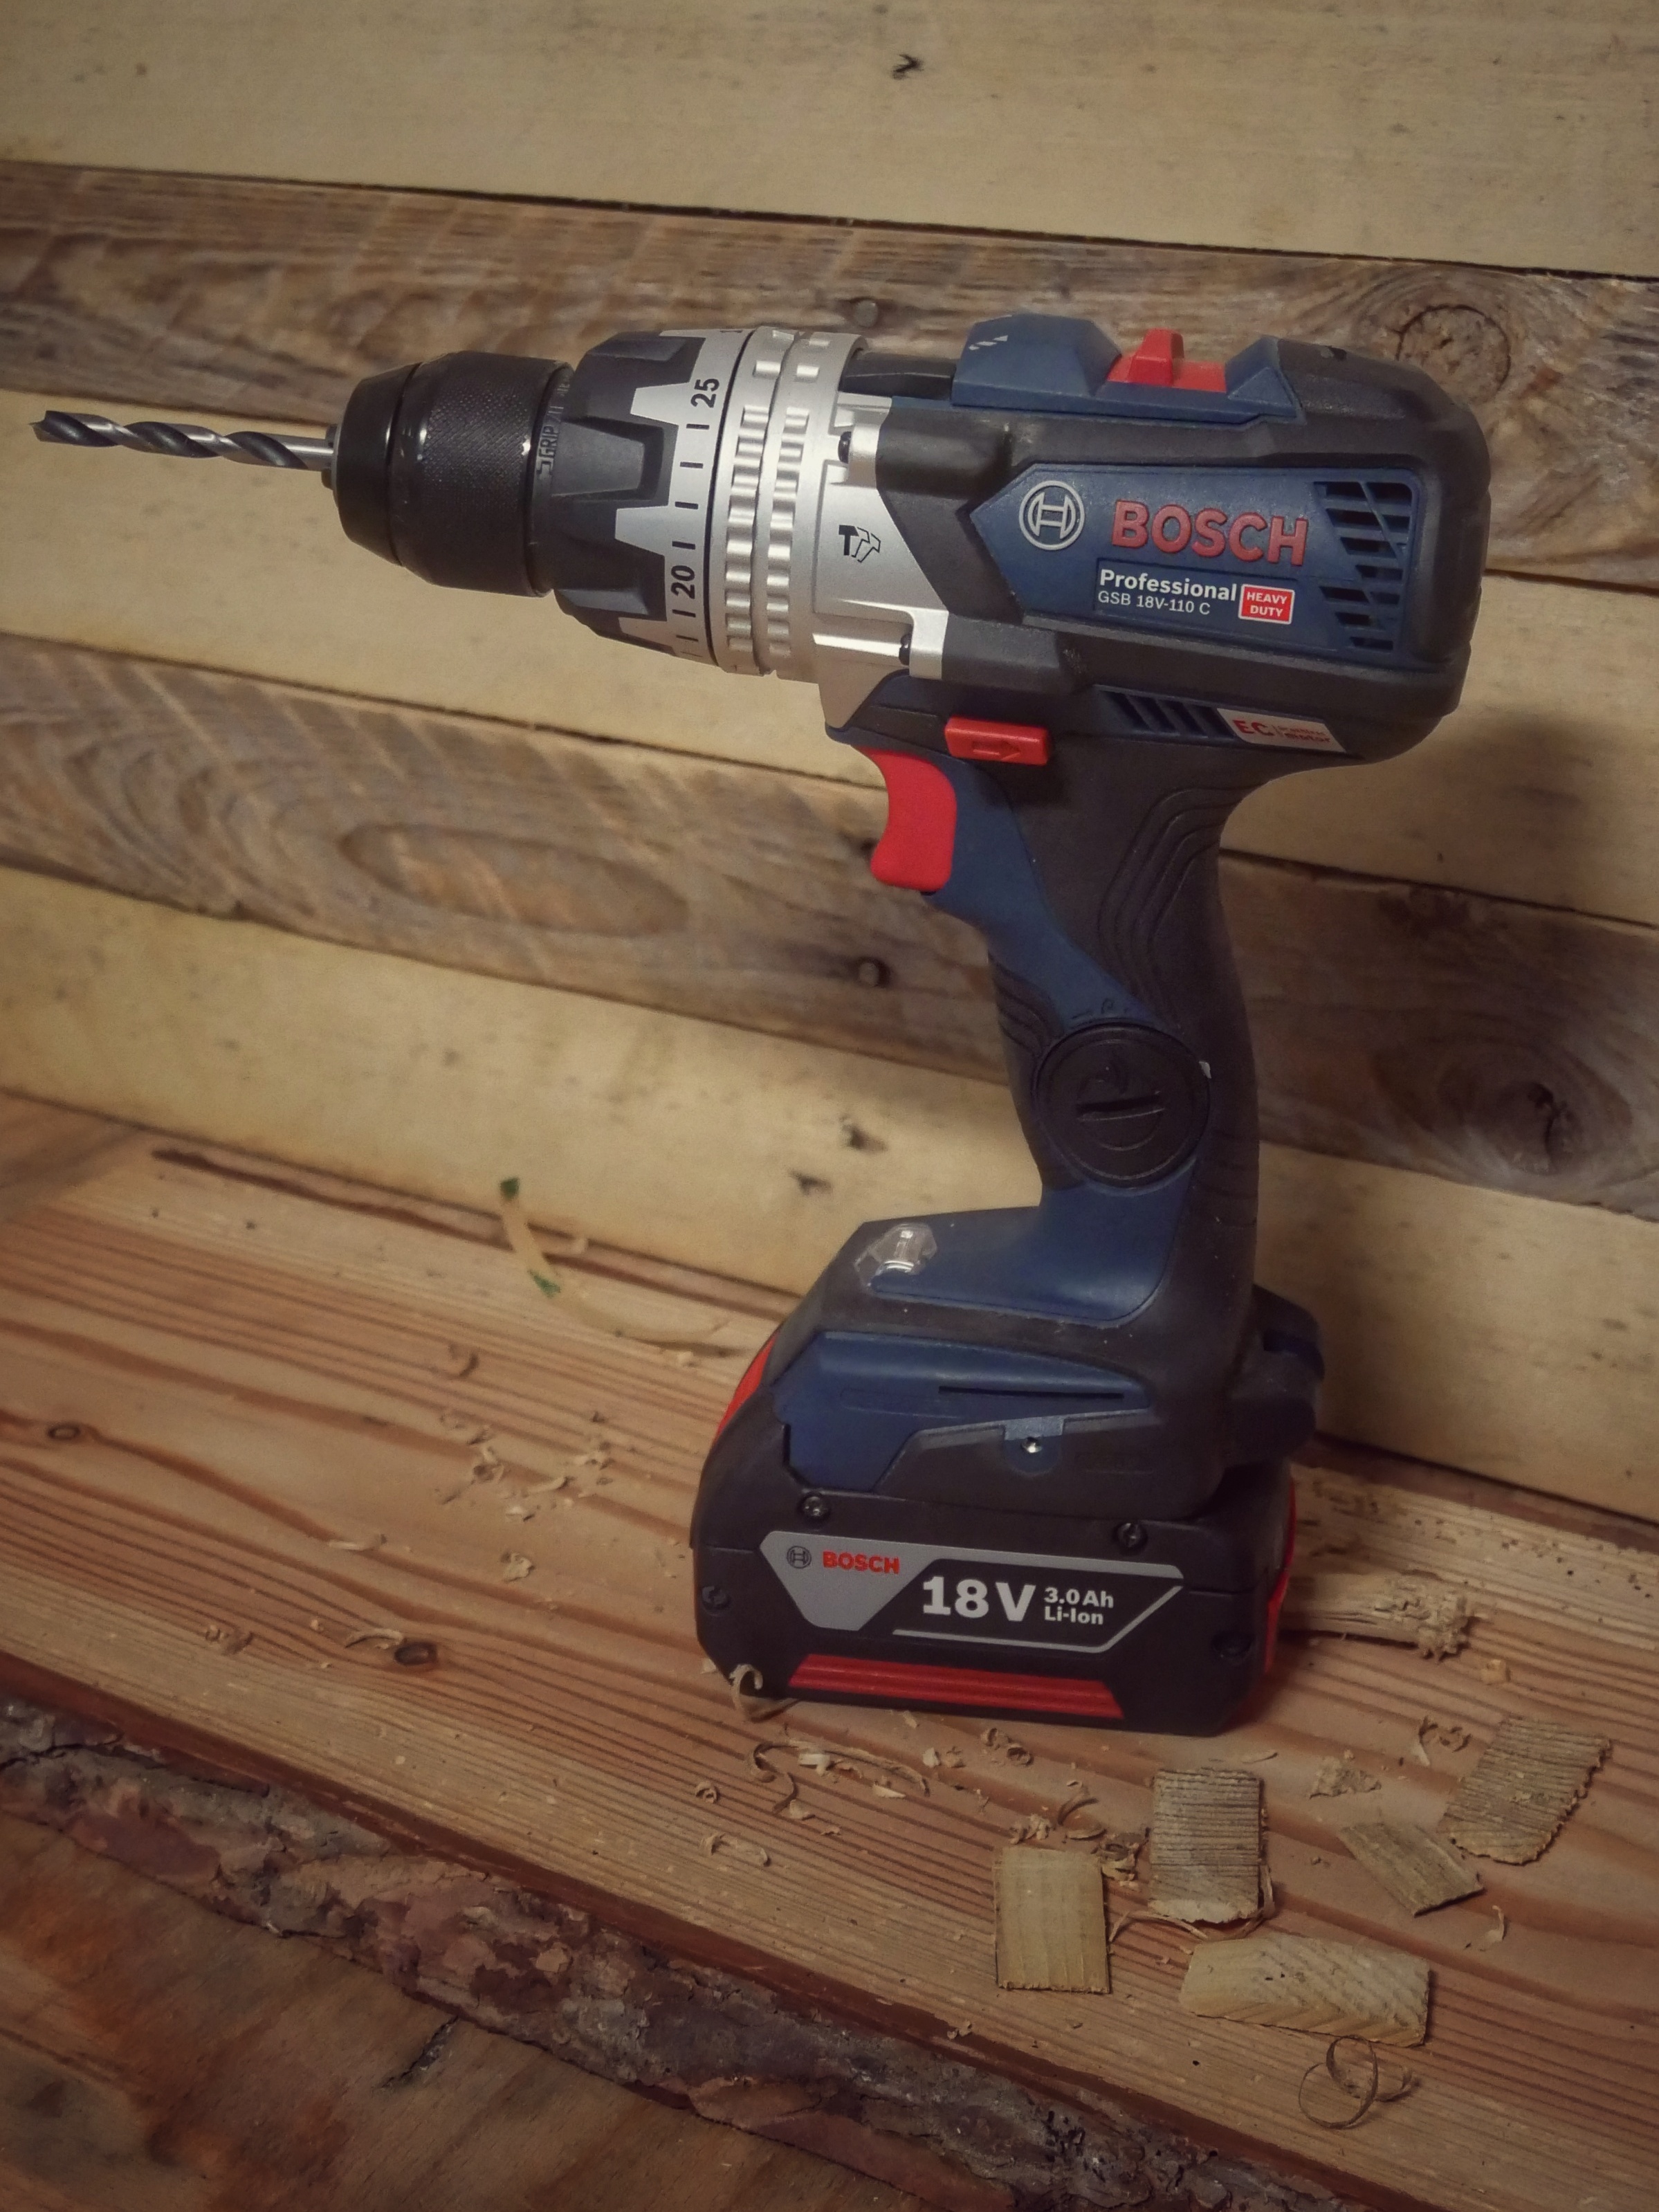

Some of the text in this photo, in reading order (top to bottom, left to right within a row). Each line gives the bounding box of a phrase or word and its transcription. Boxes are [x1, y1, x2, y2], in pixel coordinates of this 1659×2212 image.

[692, 378, 719, 408] 25
[538, 425, 559, 459] GRIP
[1111, 498, 1308, 567] BOSCH
[671, 565, 696, 599] 20
[1099, 569, 1238, 601] Professional
[1097, 590, 1211, 616] GSB 18V-110 C
[1247, 591, 1287, 605] HEAVY
[1249, 605, 1284, 617] DUTY
[1232, 720, 1274, 737] EC
[822, 1551, 900, 1574] BOSCH
[1043, 1605, 1104, 1625] Li-Ion
